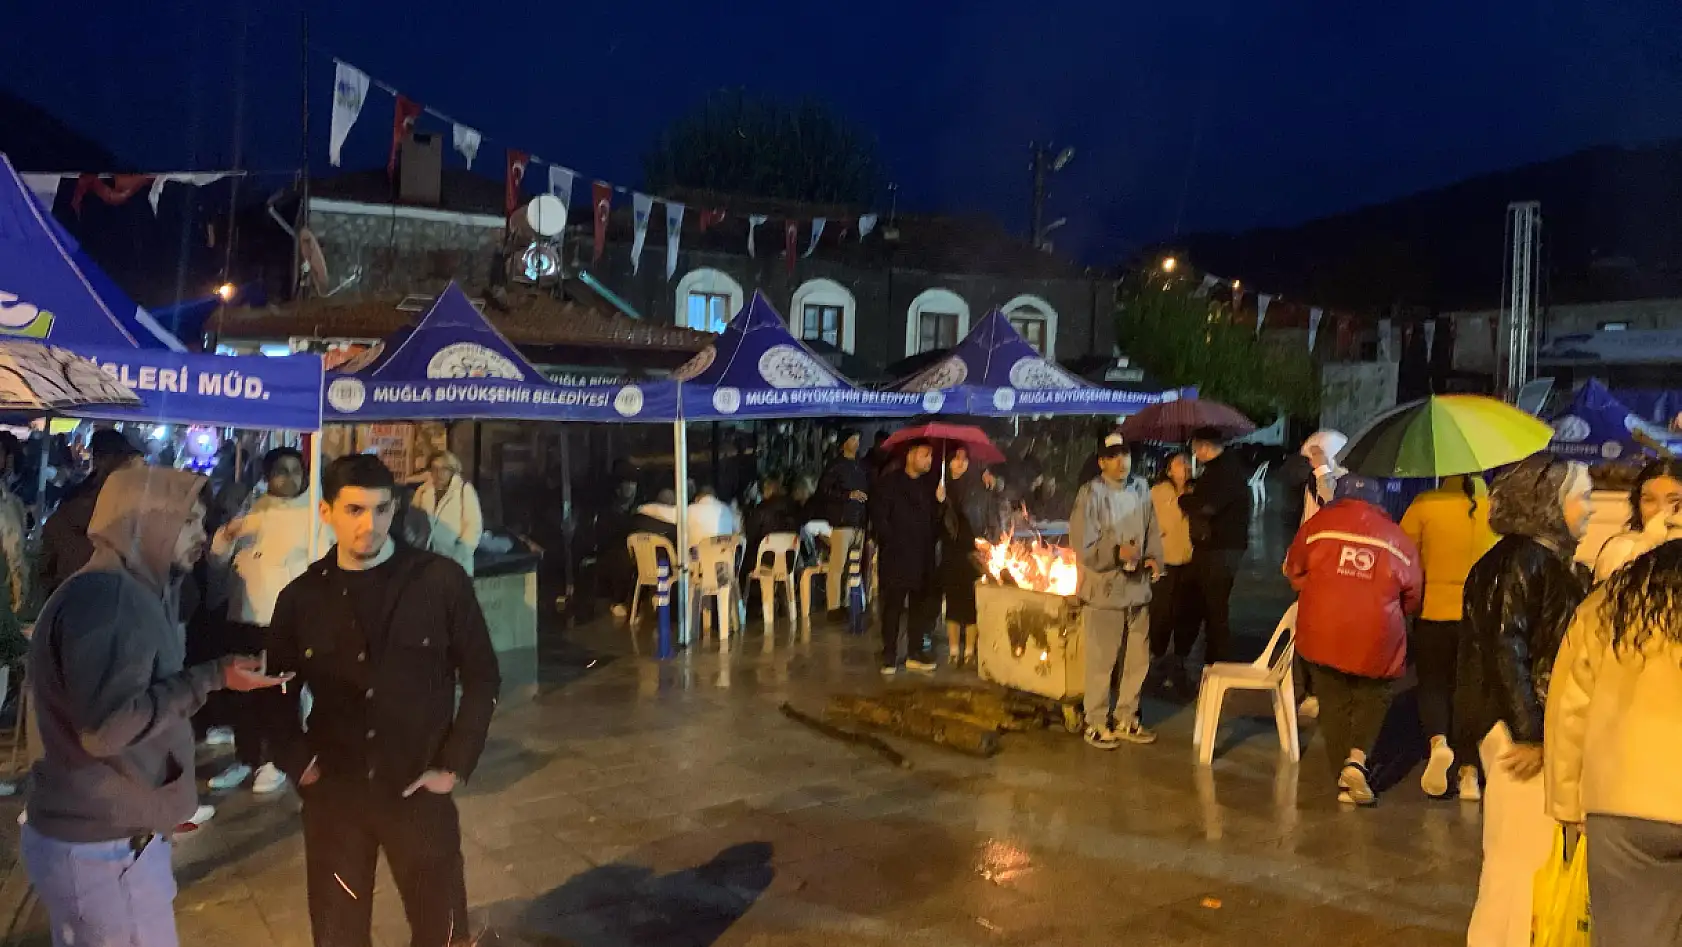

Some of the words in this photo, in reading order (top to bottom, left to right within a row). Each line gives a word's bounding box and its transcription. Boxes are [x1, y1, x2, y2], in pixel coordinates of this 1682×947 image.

[91, 356, 188, 393] LERİ
[198, 369, 270, 400] MÜD.
[373, 384, 432, 403] MUĞLA
[434, 384, 530, 405] BÜYÜKŞEHİR
[532, 388, 610, 407] BELEDİYESİ
[745, 390, 789, 406] MUĞLA
[790, 388, 859, 406] BÜYÜKŞEHİR
[1019, 390, 1053, 405] MUĞLA
[1339, 544, 1375, 571] PO
